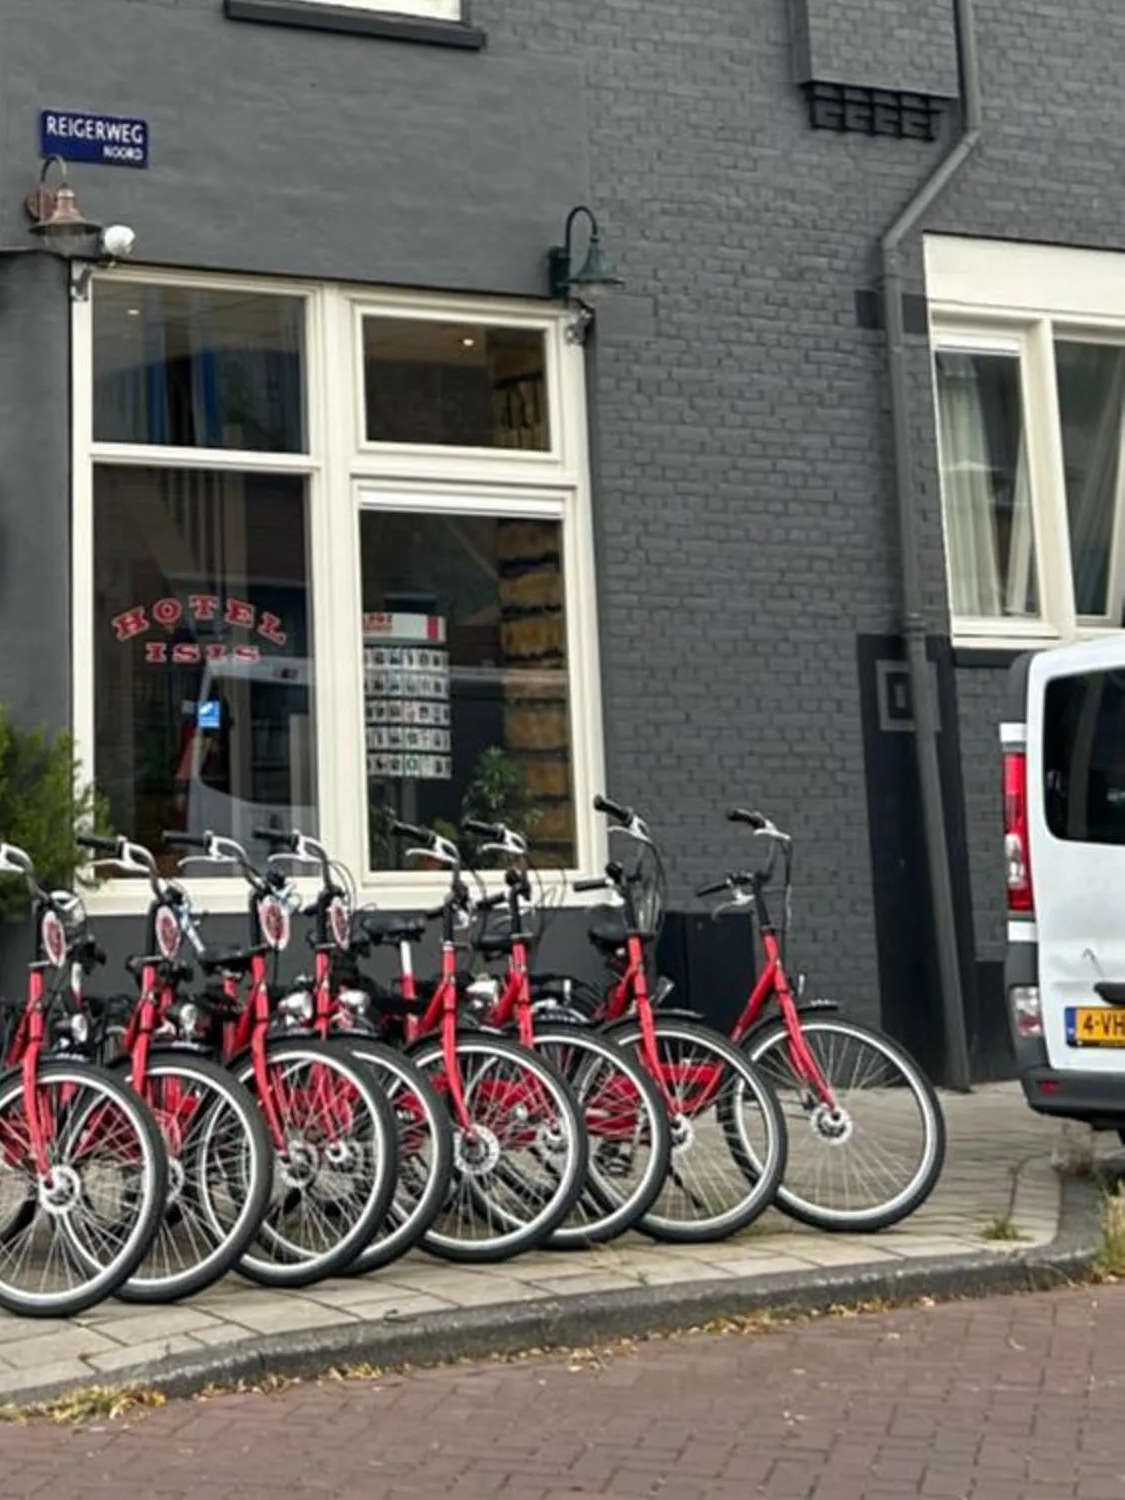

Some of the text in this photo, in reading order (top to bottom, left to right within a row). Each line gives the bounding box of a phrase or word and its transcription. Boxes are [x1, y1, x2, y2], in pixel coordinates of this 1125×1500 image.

[46, 115, 144, 145] REIGERWEG
[102, 145, 144, 160] NOORD
[111, 594, 287, 646] HOTEL
[145, 642, 260, 664] ISIS
